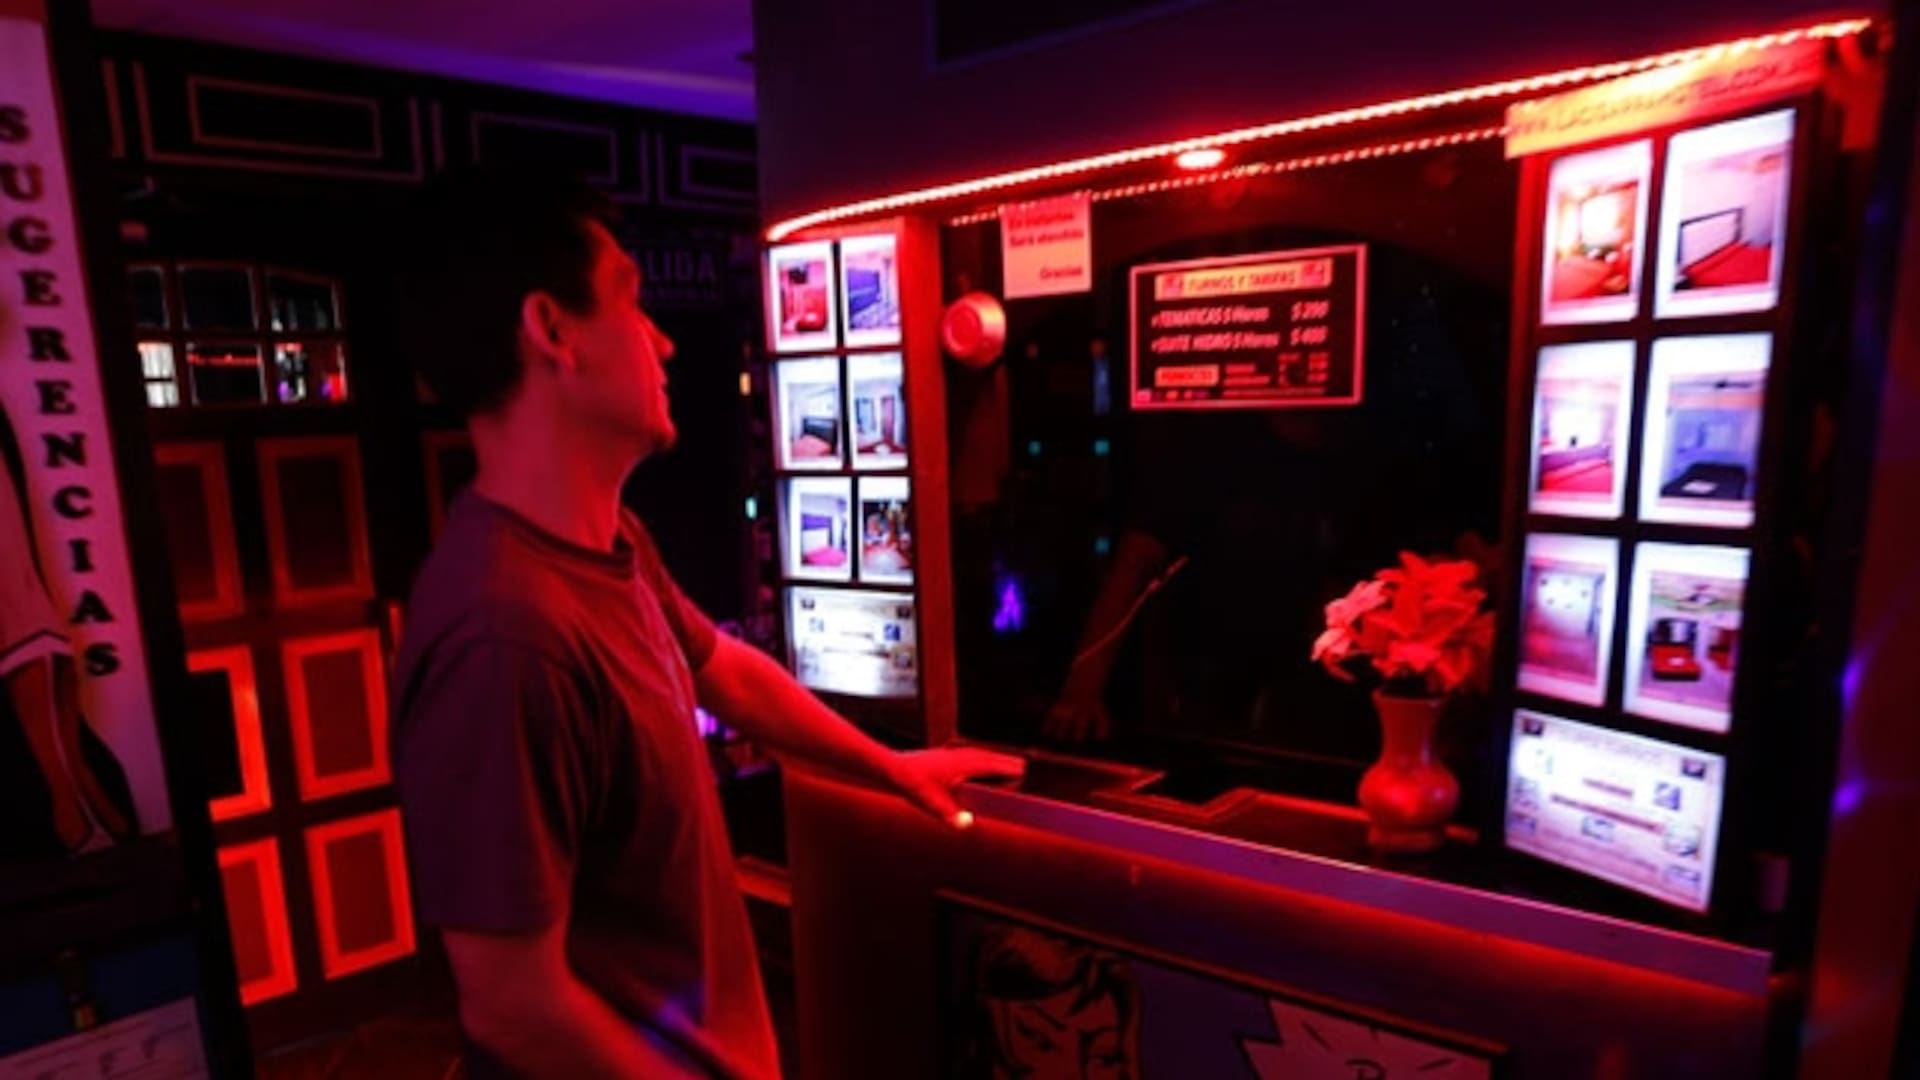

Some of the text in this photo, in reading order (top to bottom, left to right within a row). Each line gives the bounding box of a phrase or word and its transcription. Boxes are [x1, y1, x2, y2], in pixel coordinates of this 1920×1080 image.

[646, 250, 717, 283] LIDA
[1188, 273, 1234, 291] TURNOS
[1248, 269, 1297, 287] TARIFAS
[0, 105, 120, 678] SUGERENCIAS
